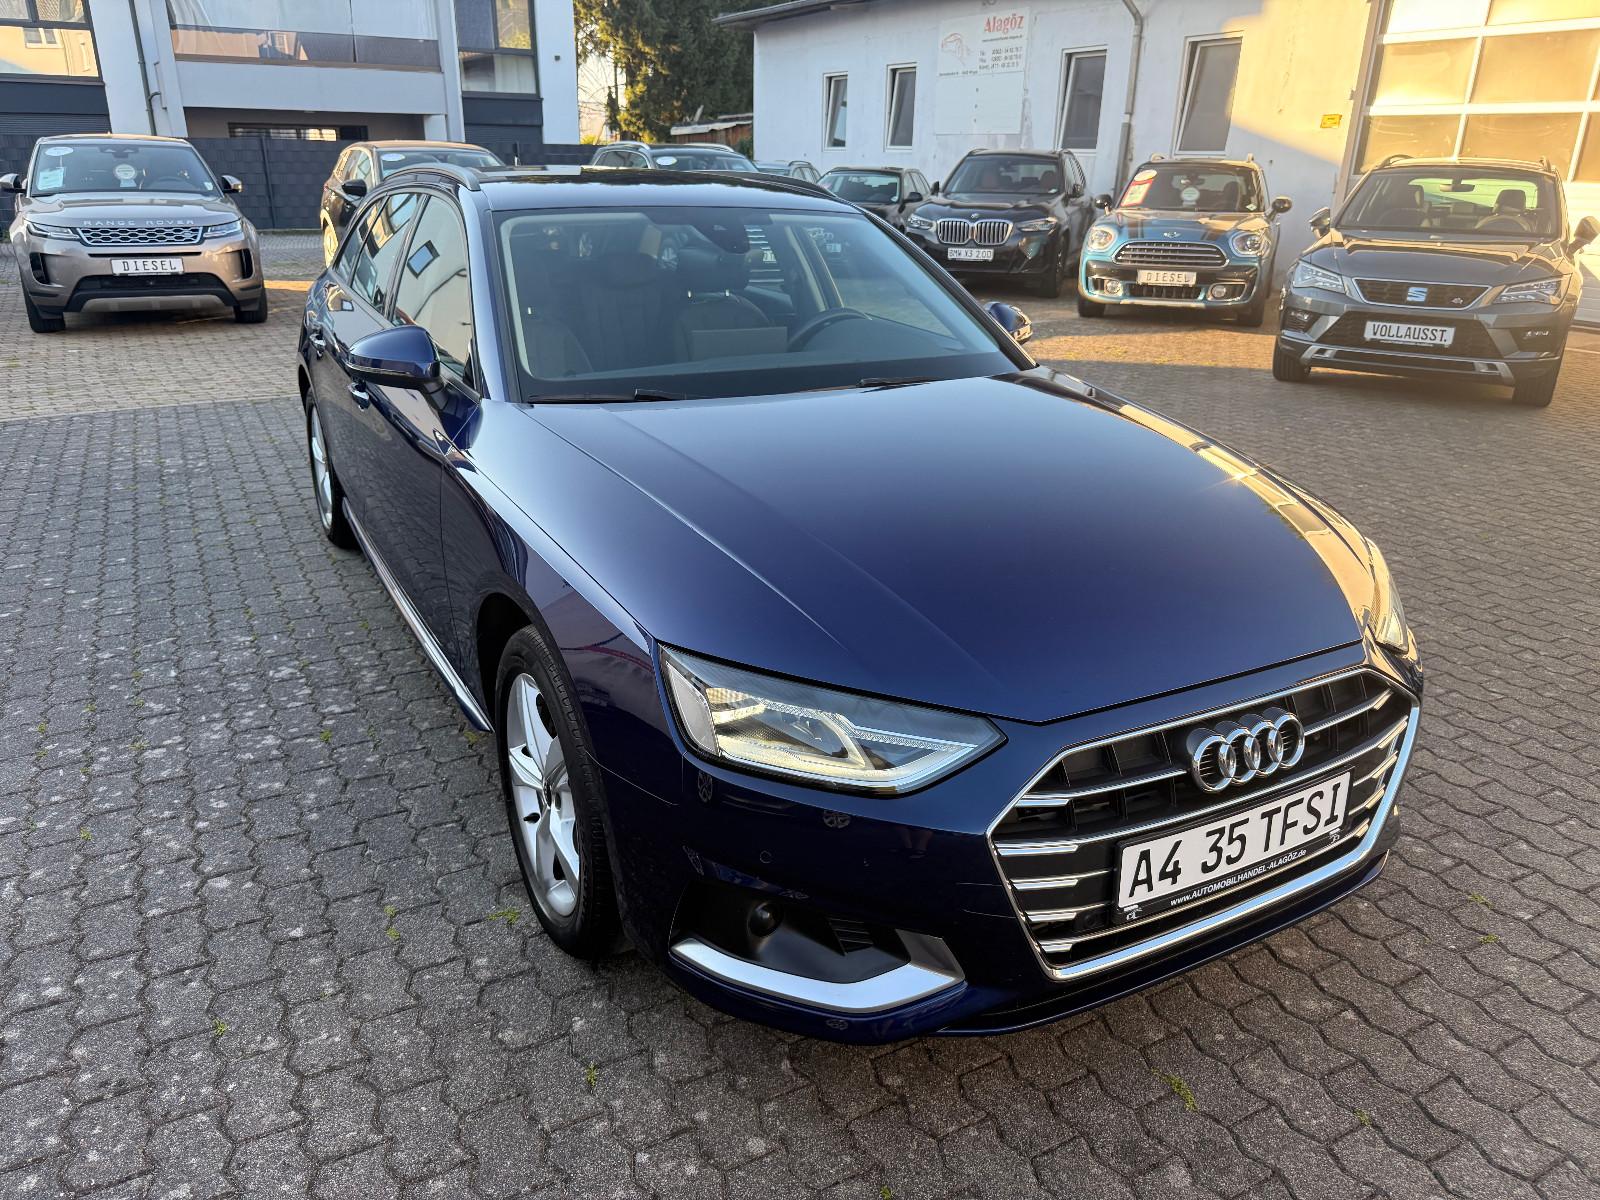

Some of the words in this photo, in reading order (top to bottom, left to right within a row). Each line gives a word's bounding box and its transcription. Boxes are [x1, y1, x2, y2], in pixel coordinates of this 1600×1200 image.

[984, 13, 1024, 33] Alagöz
[948, 249, 961, 257] BMW
[122, 261, 177, 272] DIESEL
[1146, 272, 1191, 283] DIESEL
[1373, 323, 1447, 343] VOLLAUSST.
[1128, 839, 1183, 898] A4
[1200, 817, 1250, 874] 35
[1260, 782, 1342, 852] TFSI
